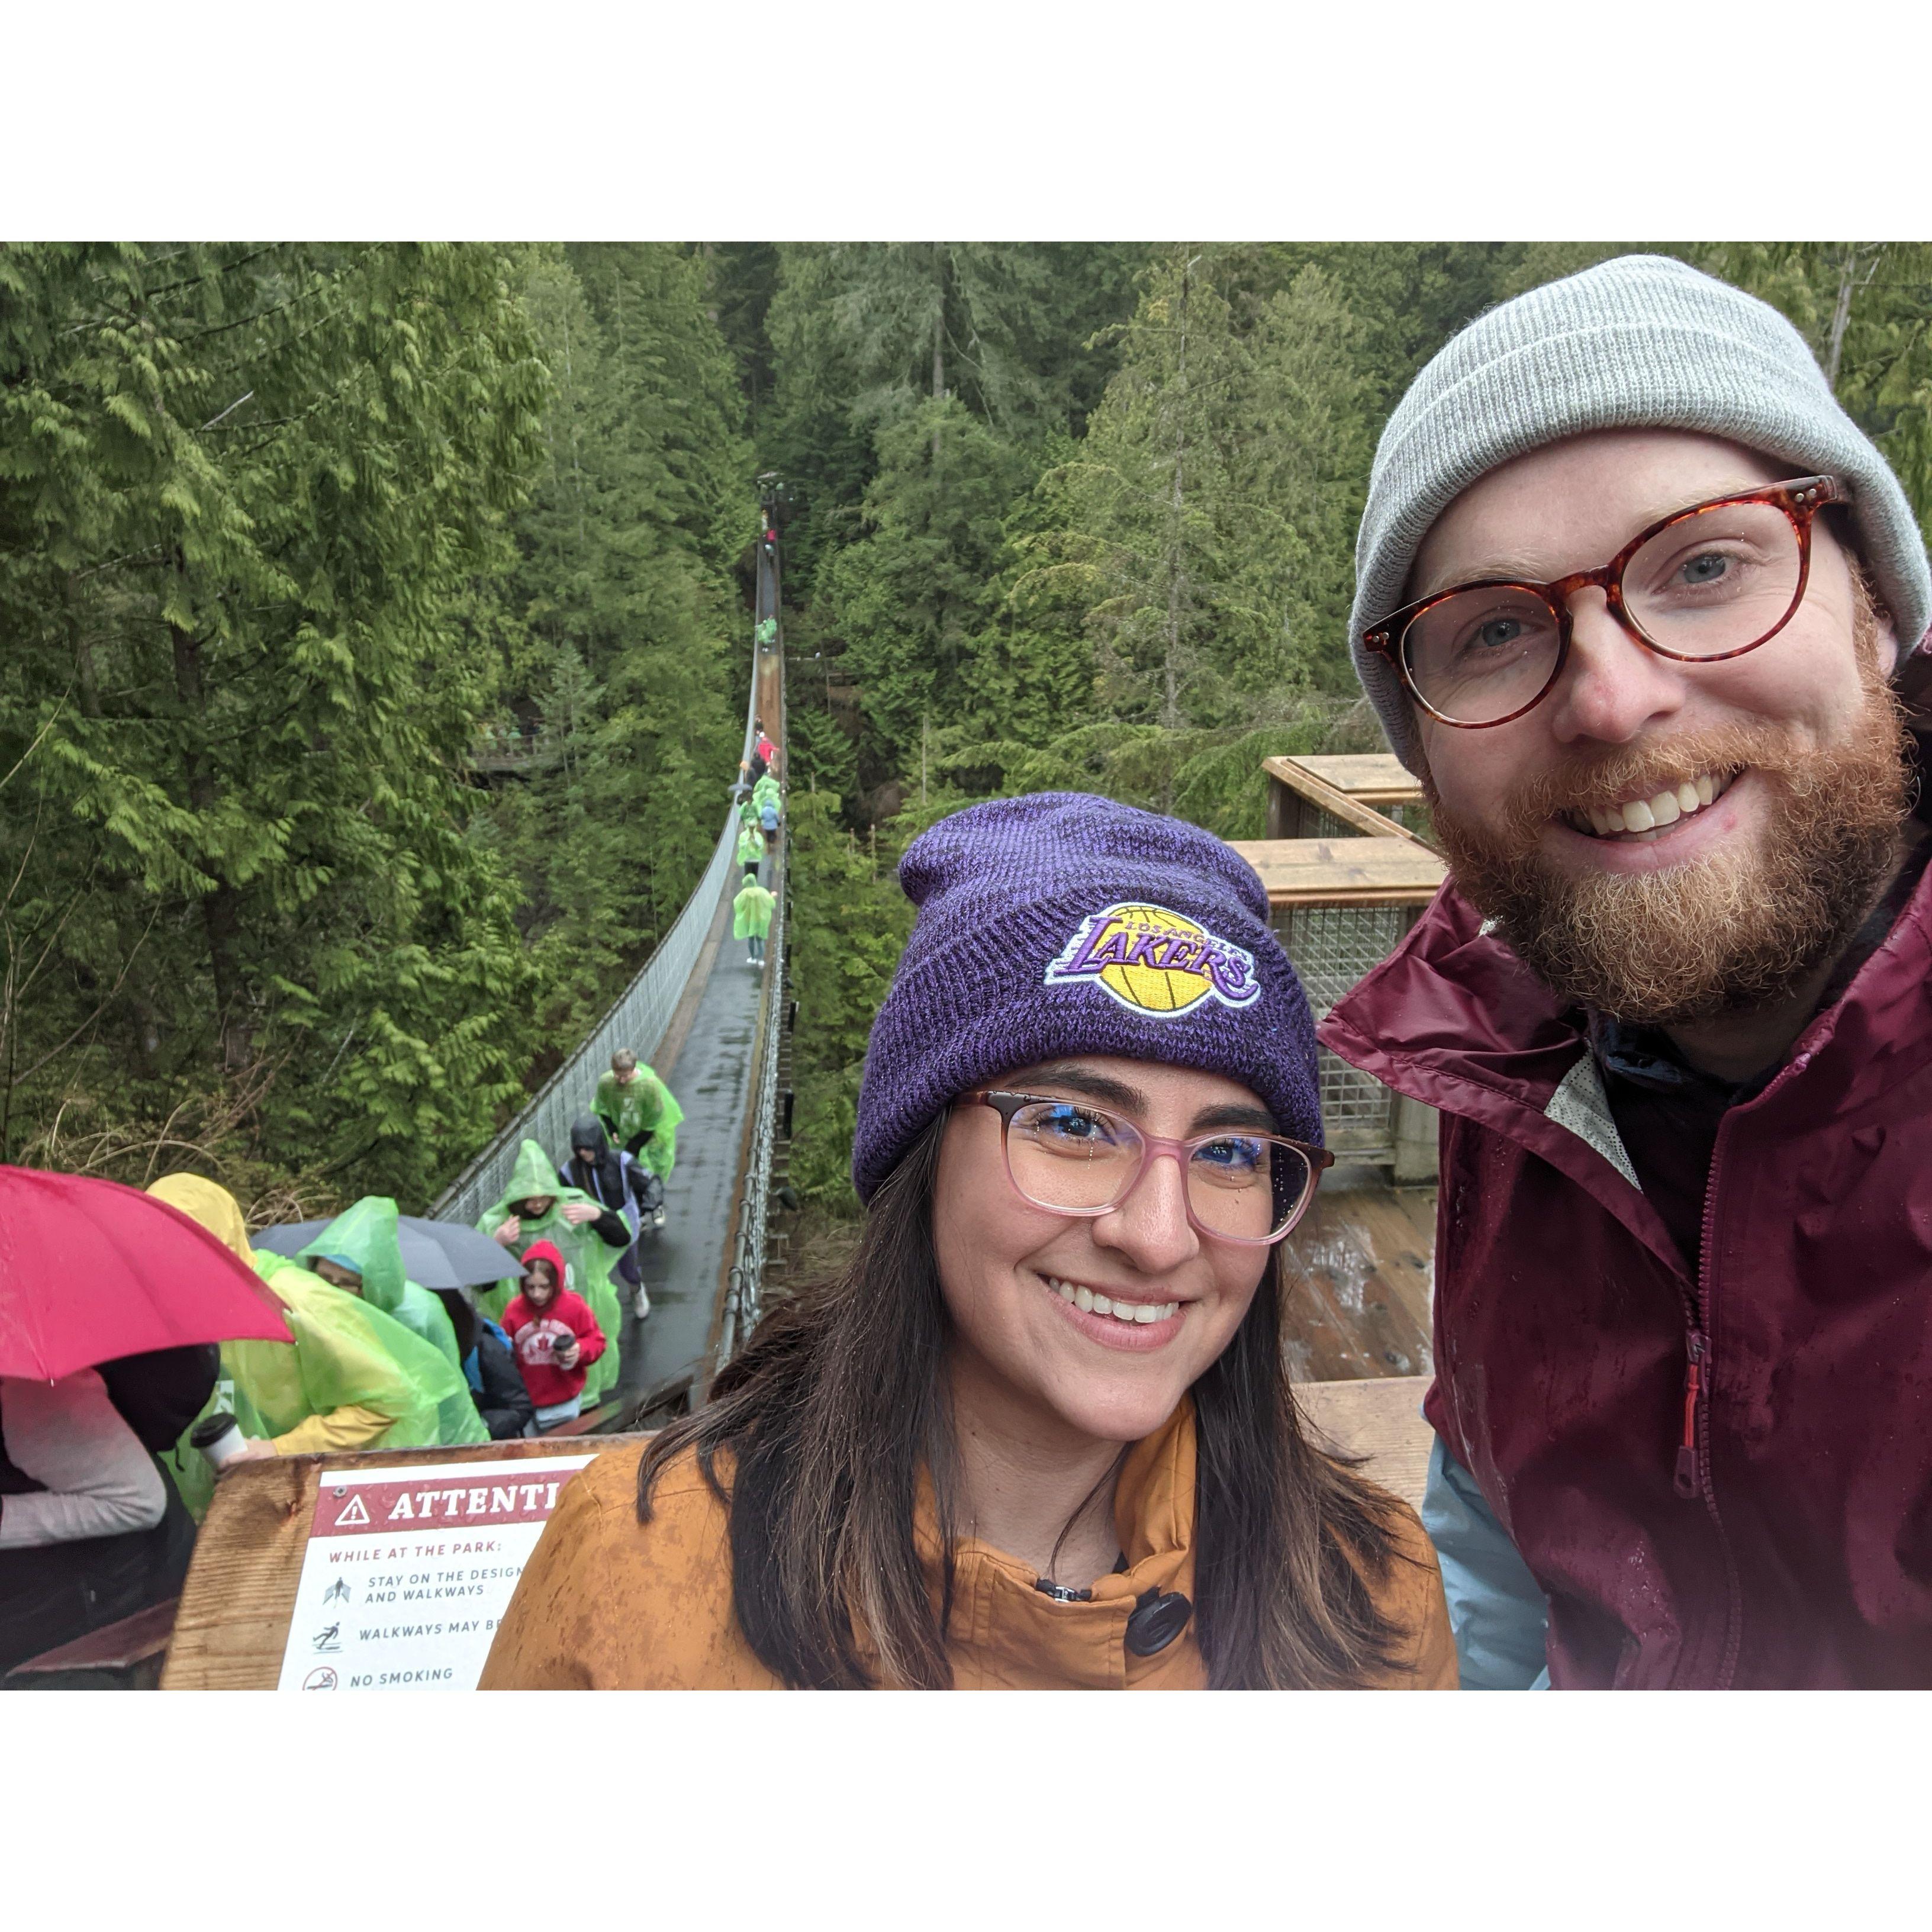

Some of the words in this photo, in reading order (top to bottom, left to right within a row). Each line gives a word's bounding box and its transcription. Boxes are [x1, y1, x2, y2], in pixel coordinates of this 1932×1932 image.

[1125, 921, 1163, 933] LOS
[1054, 916, 1259, 1000] LAKERS
[388, 1482, 560, 1519] ATTENTI
[329, 1549, 381, 1563] WHILE
[388, 1547, 407, 1559] AT
[415, 1544, 445, 1557] THE
[453, 1541, 501, 1554] PARK:
[368, 1575, 403, 1588] STAY
[409, 1573, 430, 1585] ON
[437, 1570, 463, 1582] THE
[365, 1591, 396, 1603] AND
[403, 1585, 484, 1601] WALKWAYS
[359, 1624, 442, 1640] WALKWAYS
[448, 1620, 479, 1633] MAY
[350, 1675, 373, 1687] NO
[379, 1668, 453, 1684] SMOKING
